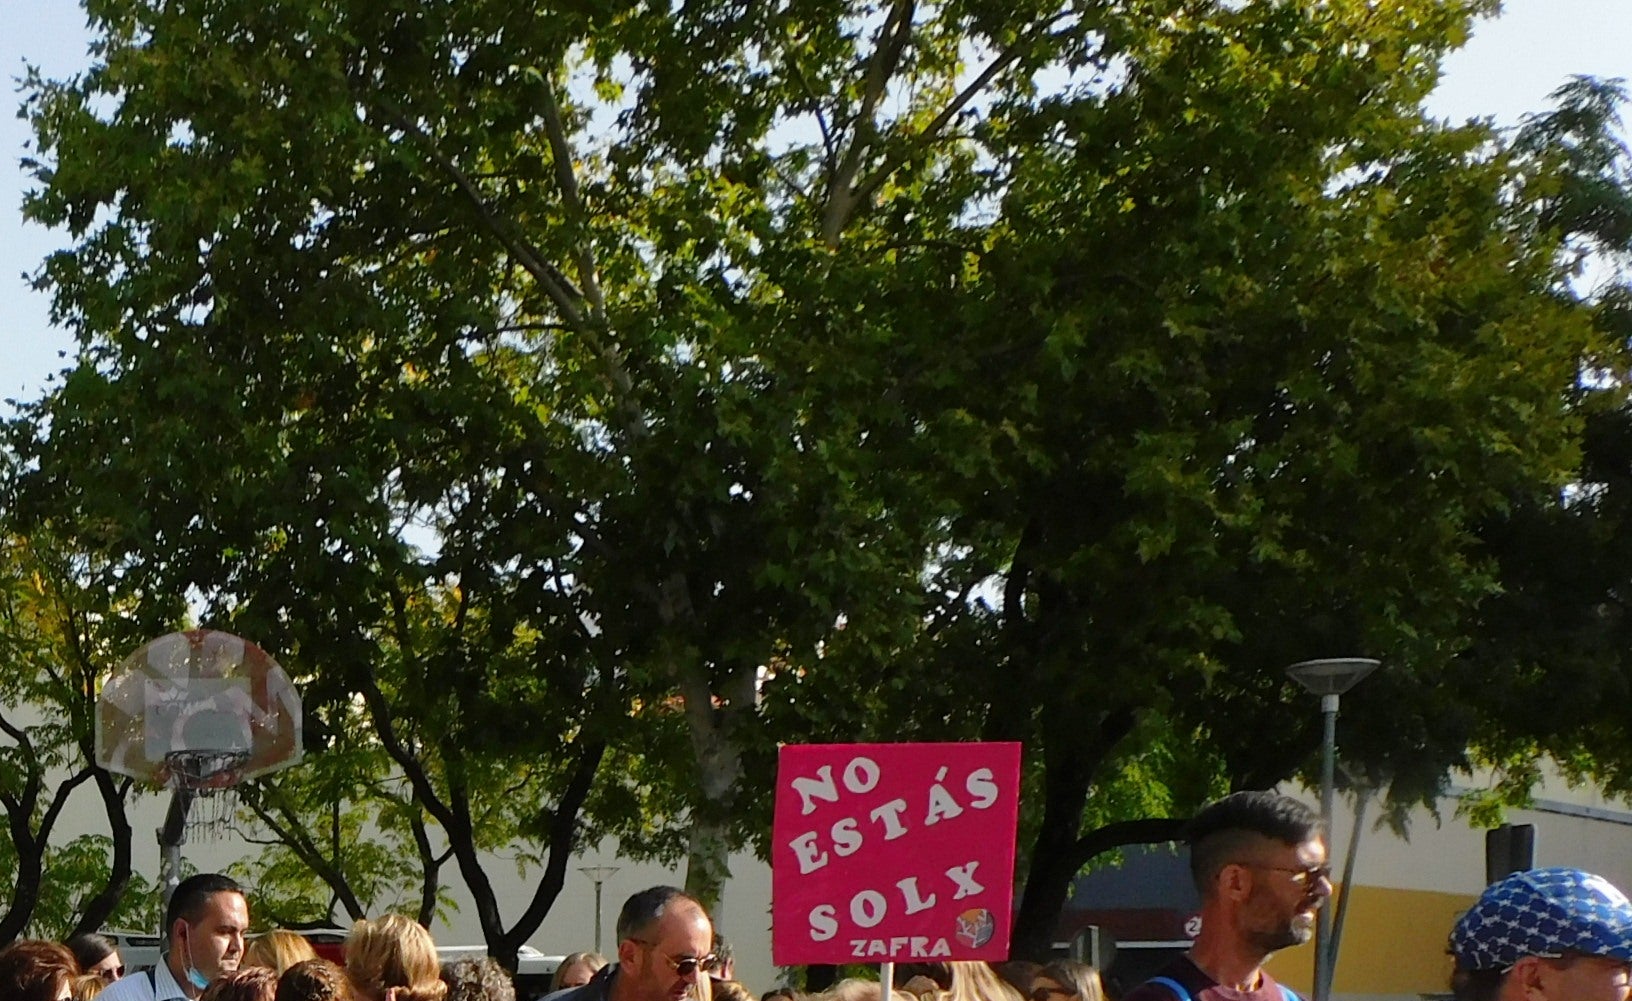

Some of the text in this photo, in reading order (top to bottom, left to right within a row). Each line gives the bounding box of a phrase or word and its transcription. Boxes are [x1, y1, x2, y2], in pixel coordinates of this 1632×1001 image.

[789, 766, 998, 874] ESTÁS
[791, 757, 880, 815] NO
[808, 861, 985, 941] SOLX
[850, 936, 951, 957] ZAFRA
